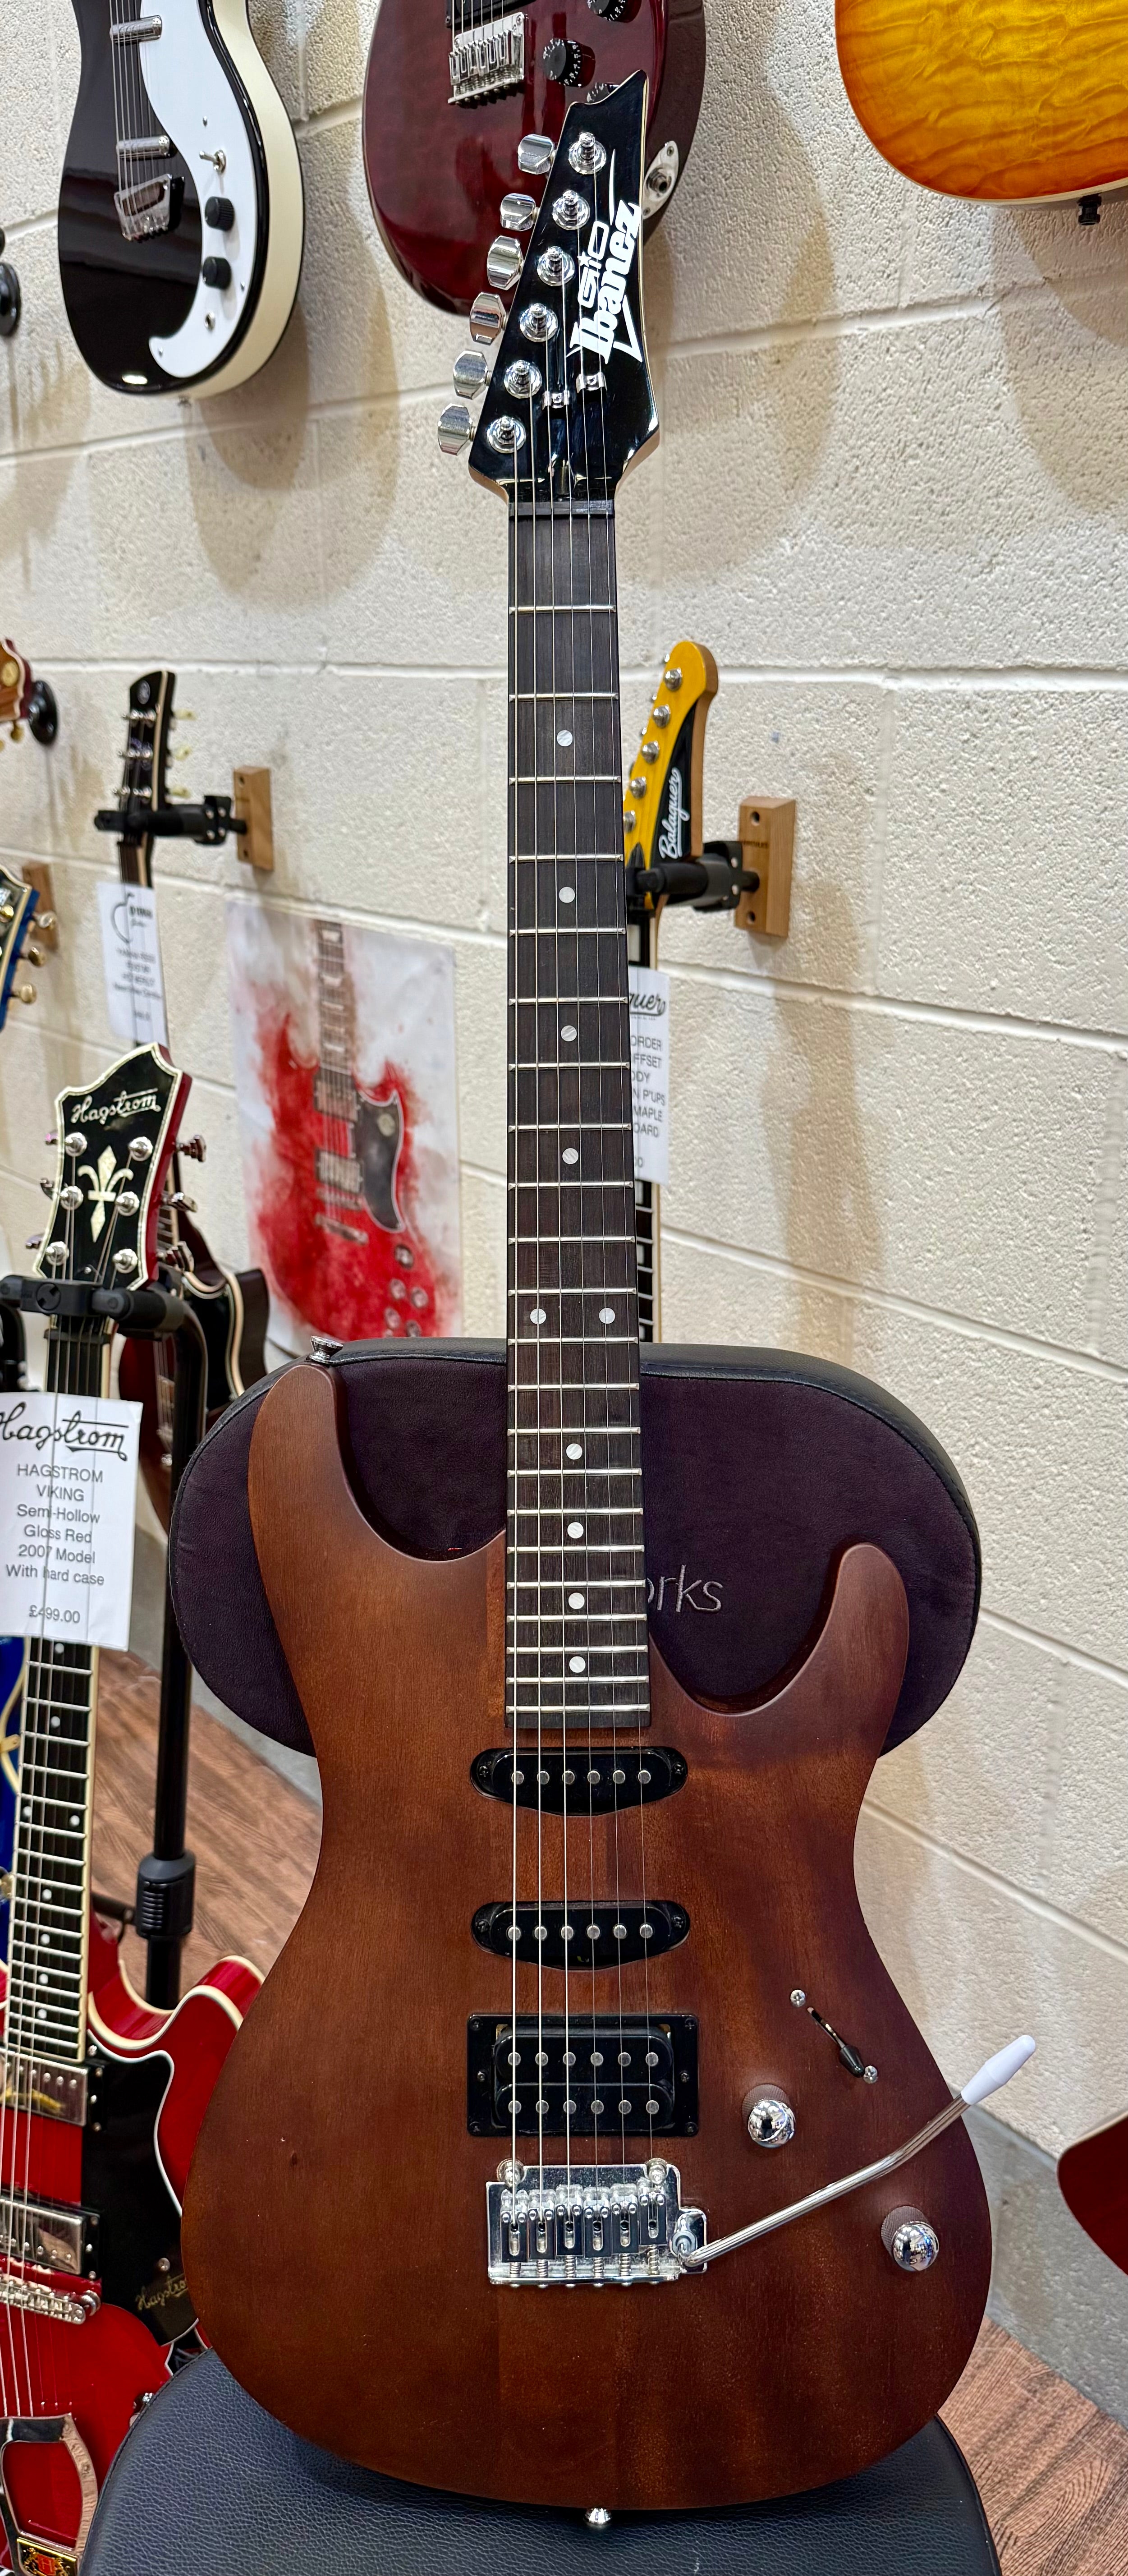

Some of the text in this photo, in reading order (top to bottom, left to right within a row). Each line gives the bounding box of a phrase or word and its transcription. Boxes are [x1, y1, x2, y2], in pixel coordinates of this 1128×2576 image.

[569, 199, 642, 365] Ibanez
[659, 767, 690, 859] Balaguer
[632, 1053, 661, 1069] FFSET
[71, 1088, 161, 1125] Hagstrom
[633, 1123, 659, 1138] OARD
[17, 1463, 103, 1483] HAGSTROM
[37, 1484, 84, 1501] VIKING
[17, 1504, 100, 1523] Semi-Hollow
[24, 1524, 92, 1543] Gloss Red
[18, 1544, 96, 1564] 2007 Model
[6, 1564, 105, 1585] With hard case
[29, 1604, 81, 1624] £499.00
[136, 2275, 186, 2310] Hagstro
